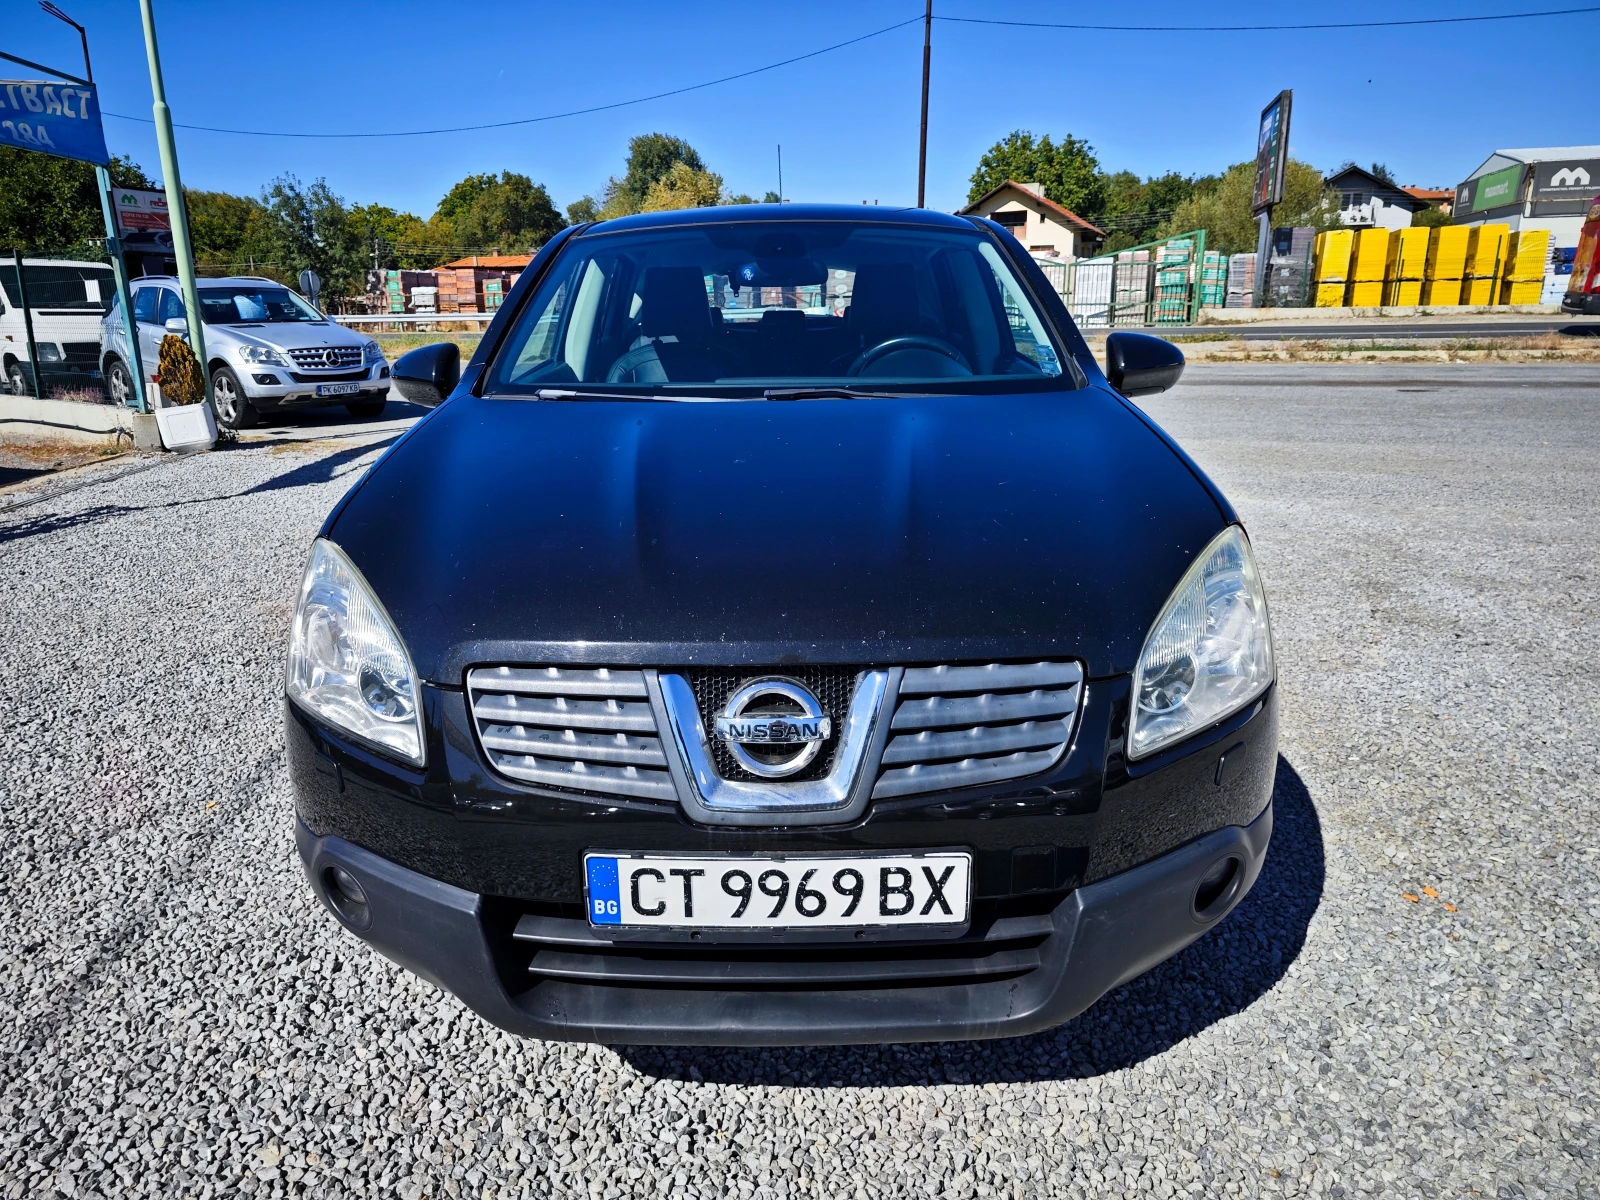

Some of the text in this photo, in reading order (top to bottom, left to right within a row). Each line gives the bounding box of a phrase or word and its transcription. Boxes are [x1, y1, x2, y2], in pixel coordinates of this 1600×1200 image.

[0, 120, 56, 149] 284
[322, 384, 359, 394] PK 6097 KB
[729, 723, 818, 738] NISSAN
[630, 865, 956, 918] CT 9969 BX
[594, 899, 618, 915] BG
